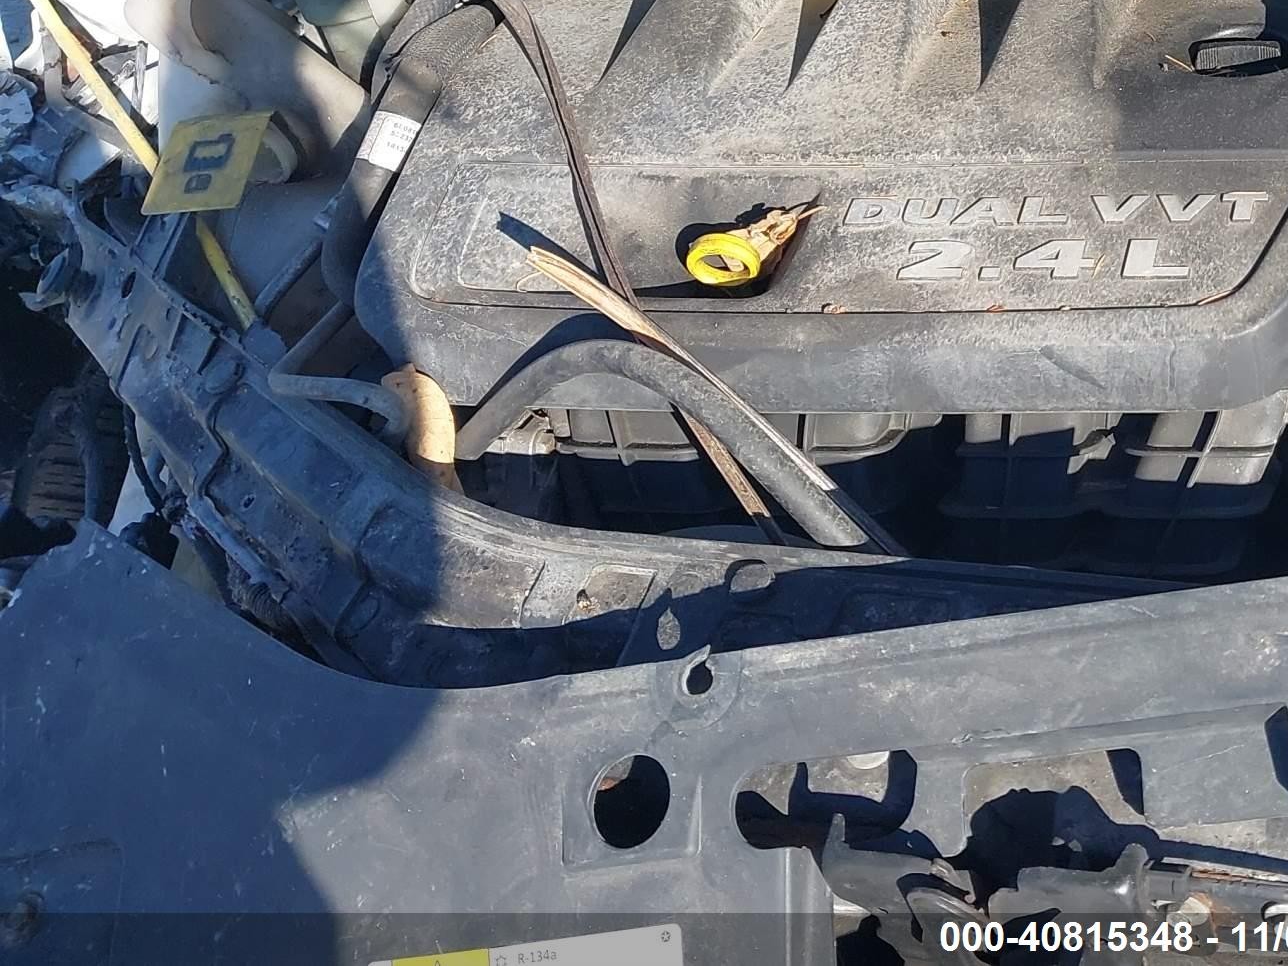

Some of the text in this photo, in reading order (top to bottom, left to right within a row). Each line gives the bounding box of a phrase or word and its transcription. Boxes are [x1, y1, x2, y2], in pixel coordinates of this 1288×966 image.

[842, 190, 1269, 226] DUAL VVT
[517, 949, 558, 964] R-134a
